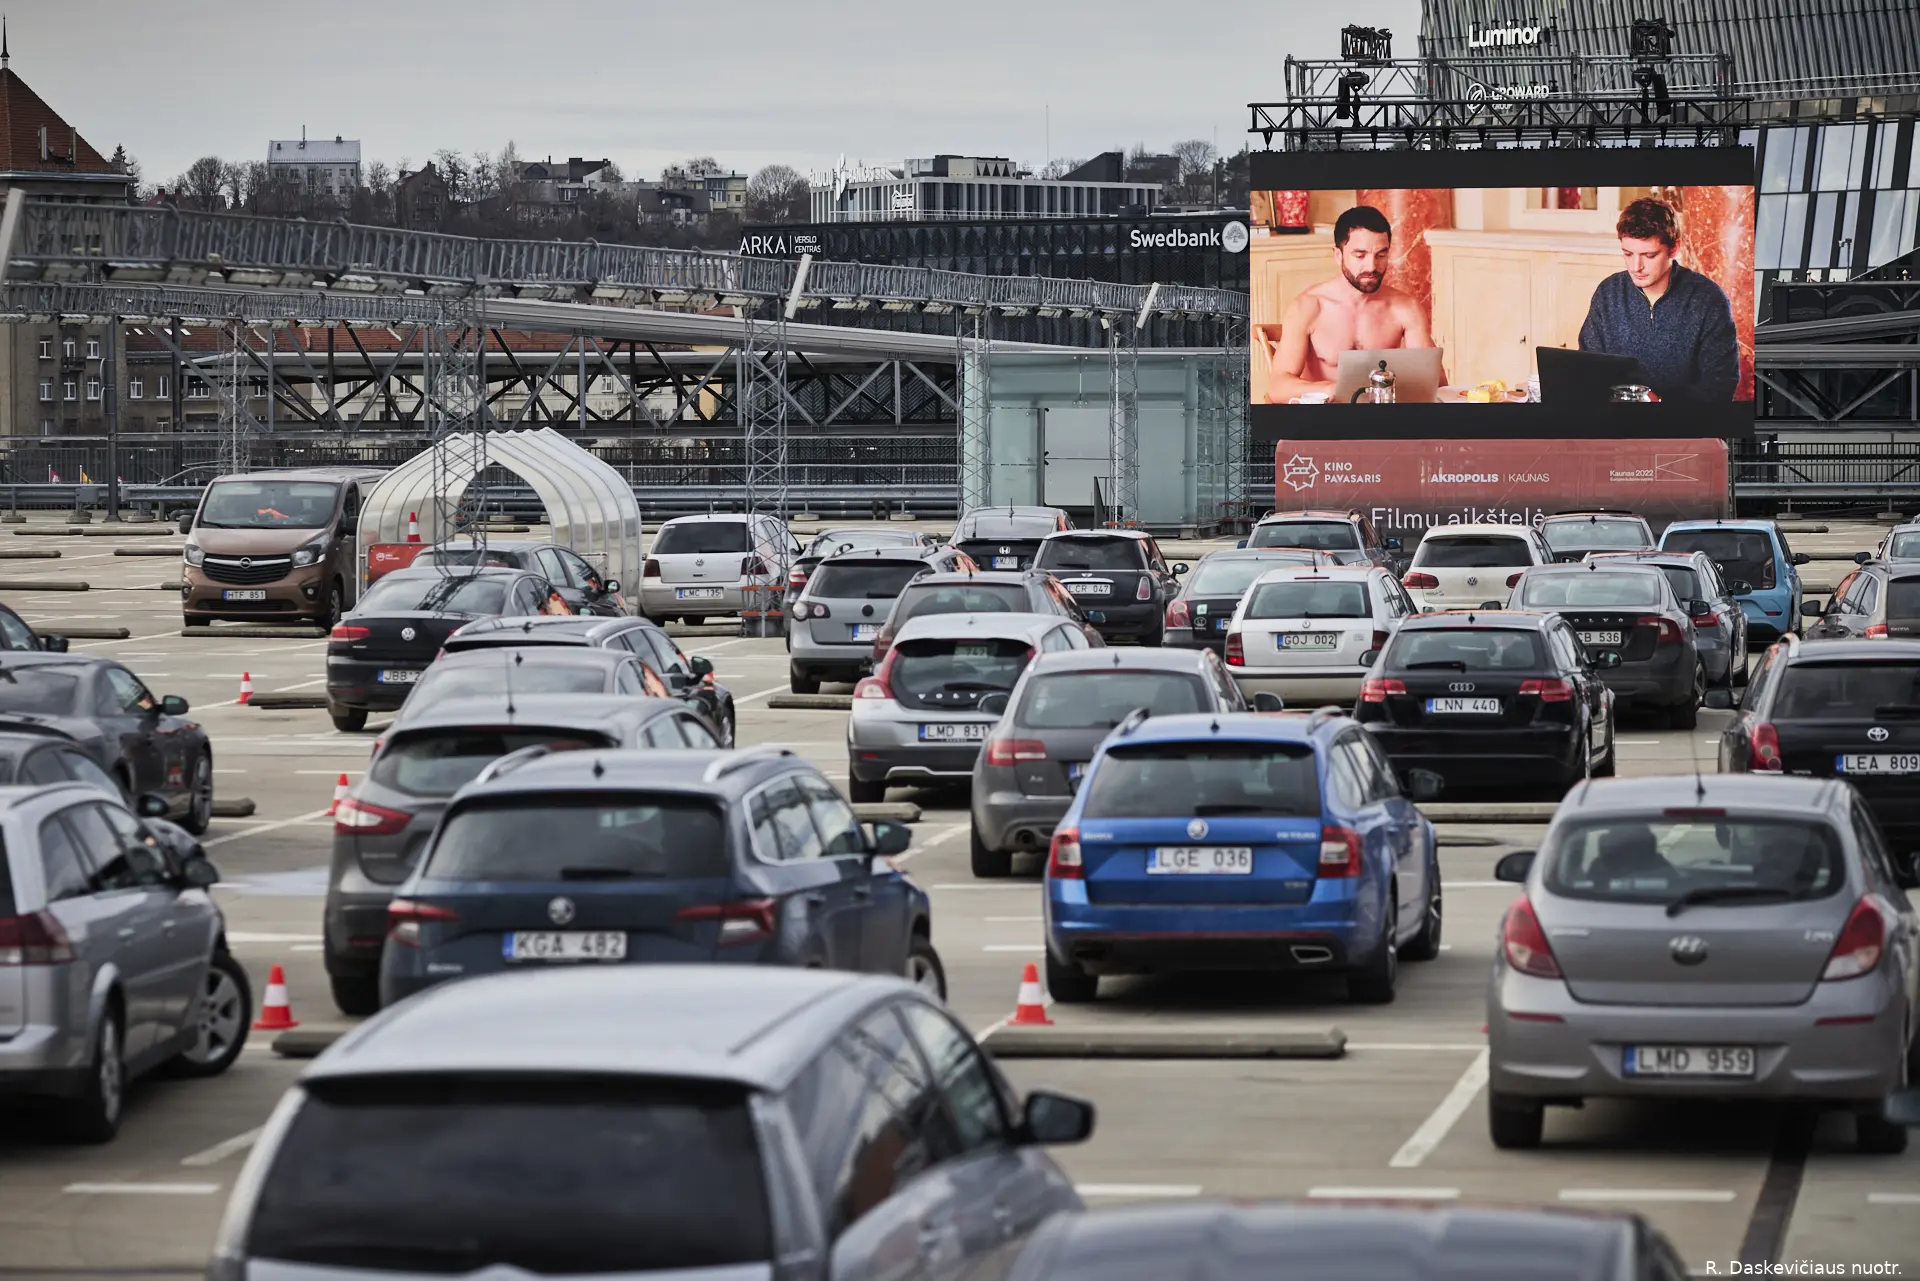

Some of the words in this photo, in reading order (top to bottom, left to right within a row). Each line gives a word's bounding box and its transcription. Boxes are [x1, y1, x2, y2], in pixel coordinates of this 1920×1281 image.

[1468, 20, 1541, 48] Luminor
[794, 235, 817, 244] VERSLO
[1130, 228, 1221, 248] Swedbank
[739, 235, 787, 255] ARKA
[794, 245, 821, 253] CENTRAS
[1324, 462, 1353, 471] KINO
[1430, 473, 1499, 483] AKROPOLIS
[1508, 473, 1550, 482] KAUNAS
[1635, 469, 1654, 477] 2022
[1324, 474, 1382, 483] PAVASARIS
[683, 588, 700, 598] LMC
[706, 588, 720, 597] 135
[1069, 585, 1088, 593] LCR
[1093, 585, 1109, 593] 047
[227, 591, 245, 600] HTF
[249, 590, 265, 599] 851
[1284, 635, 1308, 645] GOJ
[1314, 635, 1335, 645] 002
[1599, 632, 1620, 643] 536
[1435, 700, 1464, 711] LNN
[1472, 700, 1497, 711] 440
[926, 726, 955, 738] LMD
[963, 726, 987, 738] 831
[1846, 756, 1879, 770] LEA
[1890, 756, 1919, 770] 809
[1159, 850, 1200, 867] LGE
[1213, 850, 1249, 867] 036
[1638, 1047, 1690, 1071] LMD
[1706, 1047, 1751, 1070] 959
